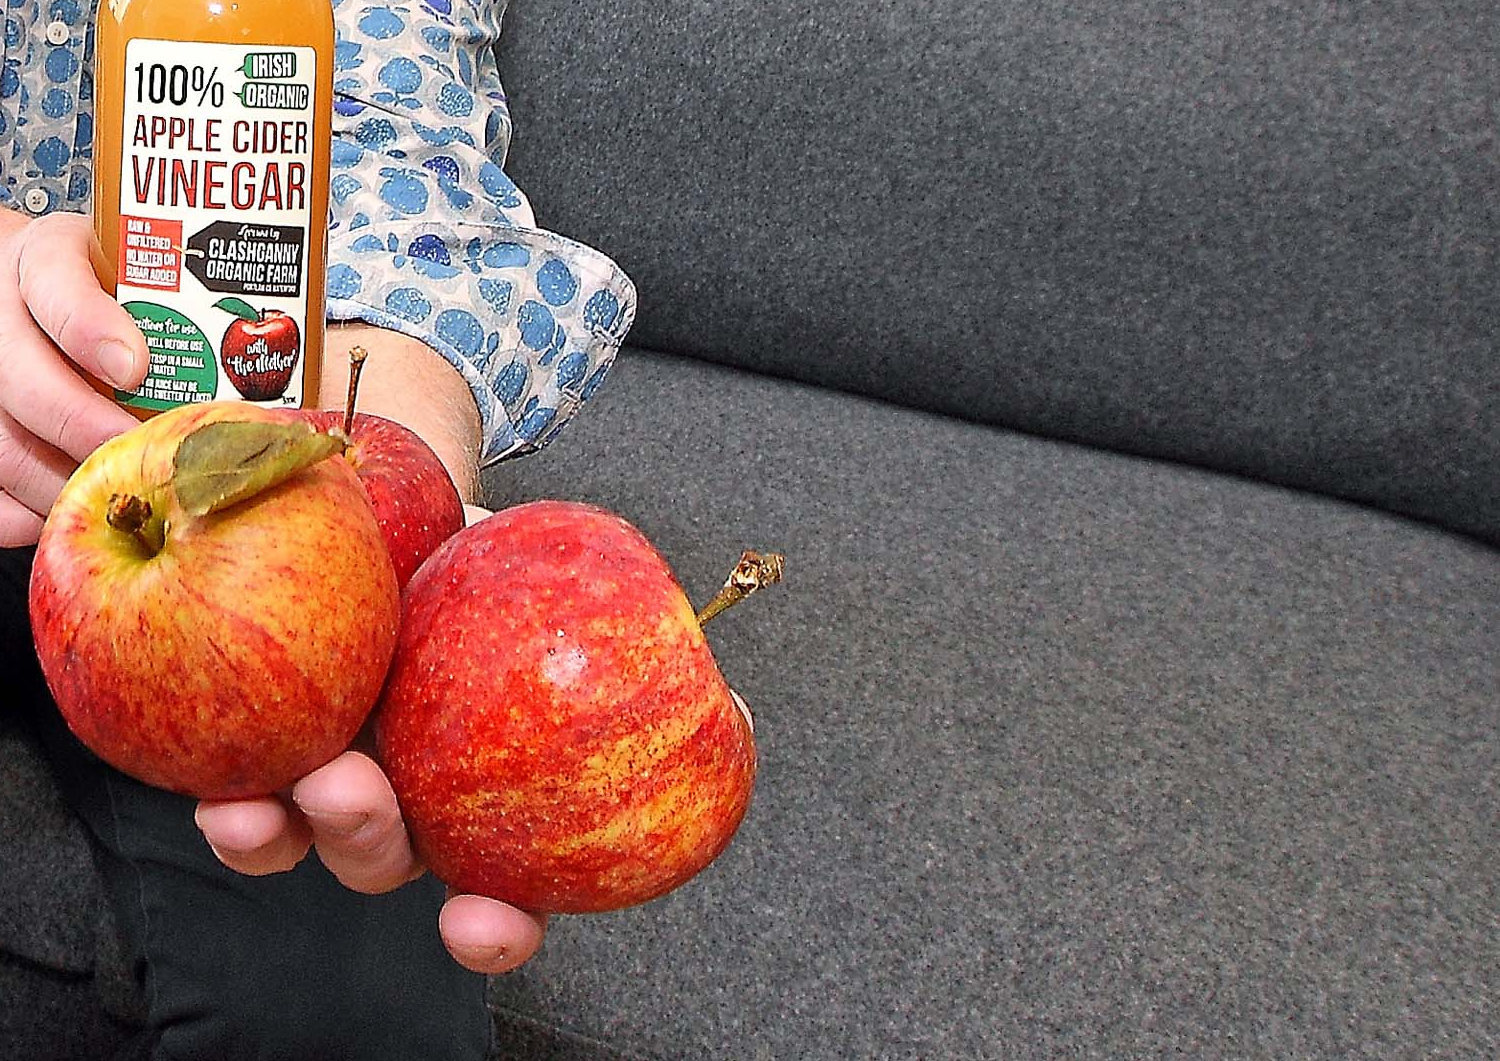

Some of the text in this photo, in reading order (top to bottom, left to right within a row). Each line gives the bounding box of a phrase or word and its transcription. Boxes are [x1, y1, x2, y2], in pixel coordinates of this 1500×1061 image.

[134, 53, 292, 108] 100% IRISH
[247, 83, 308, 109] ORGANIC
[133, 114, 307, 154] APPLE CIDER
[132, 154, 306, 211] VINEGAR
[208, 238, 299, 264] CLASHGANNY
[206, 259, 298, 284] ORGANIC FARM
